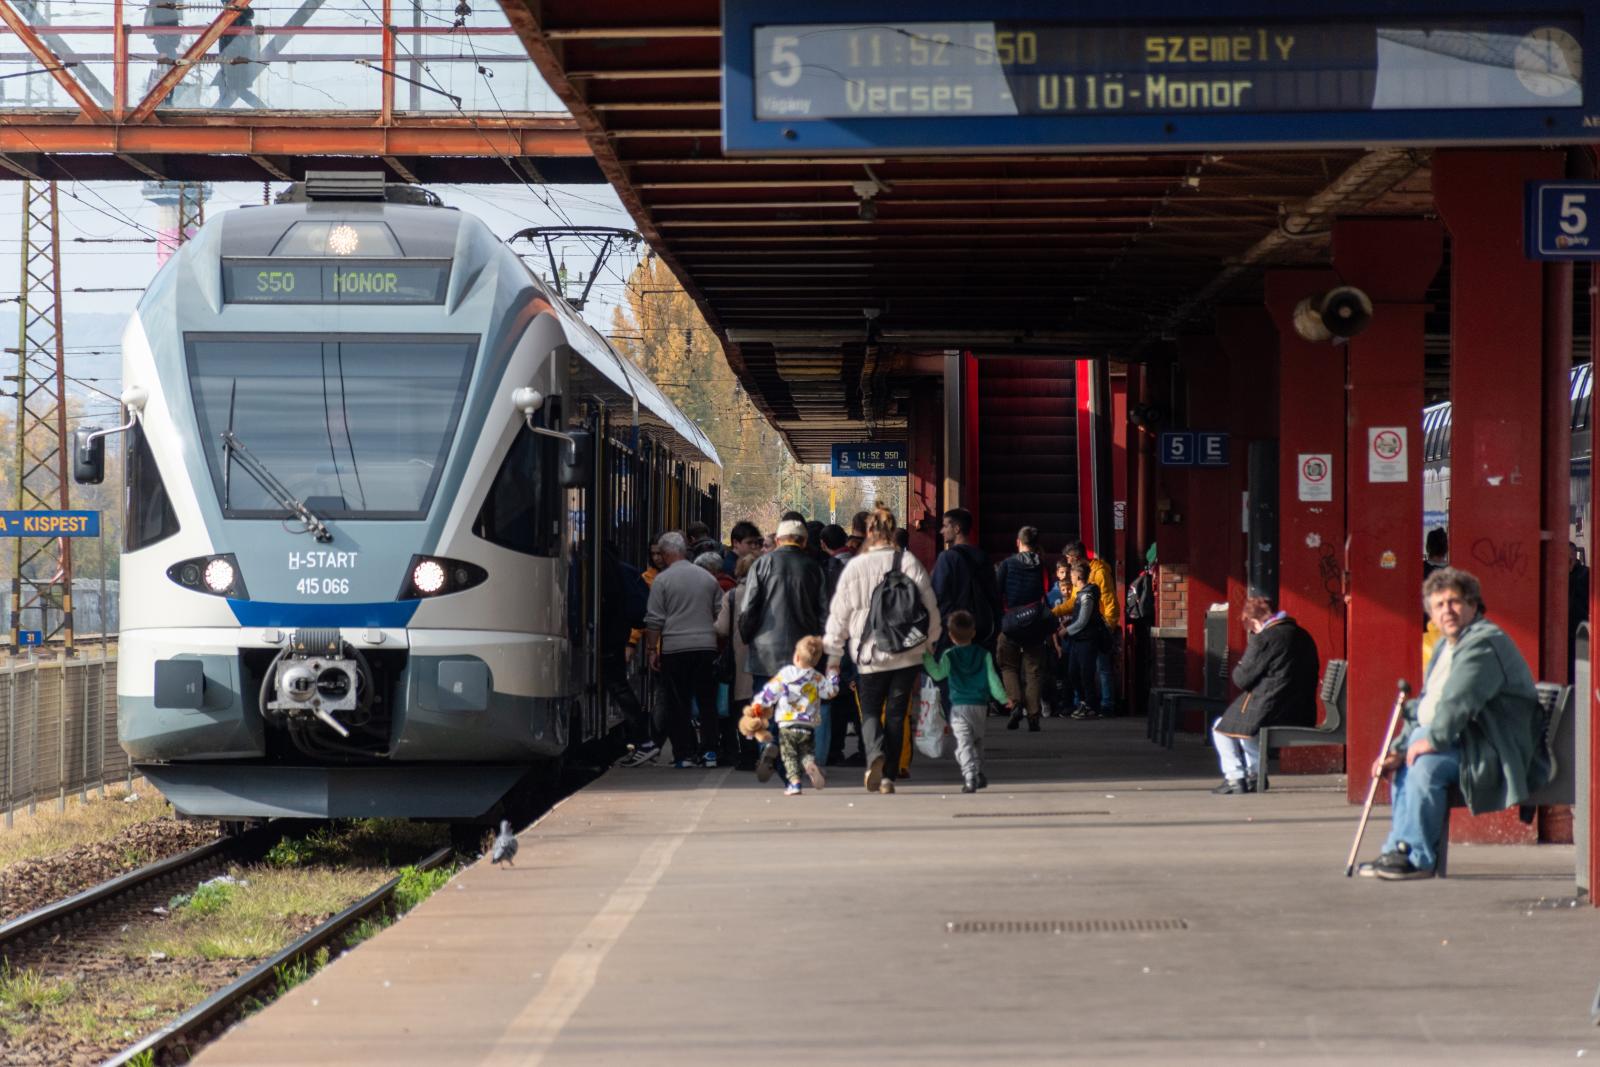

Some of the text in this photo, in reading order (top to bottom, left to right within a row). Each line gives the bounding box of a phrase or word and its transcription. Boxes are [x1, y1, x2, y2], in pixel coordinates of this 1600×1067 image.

[848, 29, 1295, 68] 11:52 S50 szemely
[768, 35, 802, 88] 5
[1559, 194, 1588, 235] 5
[256, 271, 398, 293] S50 MONOR
[1171, 437, 1184, 455] 5
[1207, 437, 1221, 455] E
[841, 452, 849, 463] 5
[24, 516, 88, 532] KISPEST
[288, 551, 358, 570] H-START
[296, 578, 349, 595] 415 066
